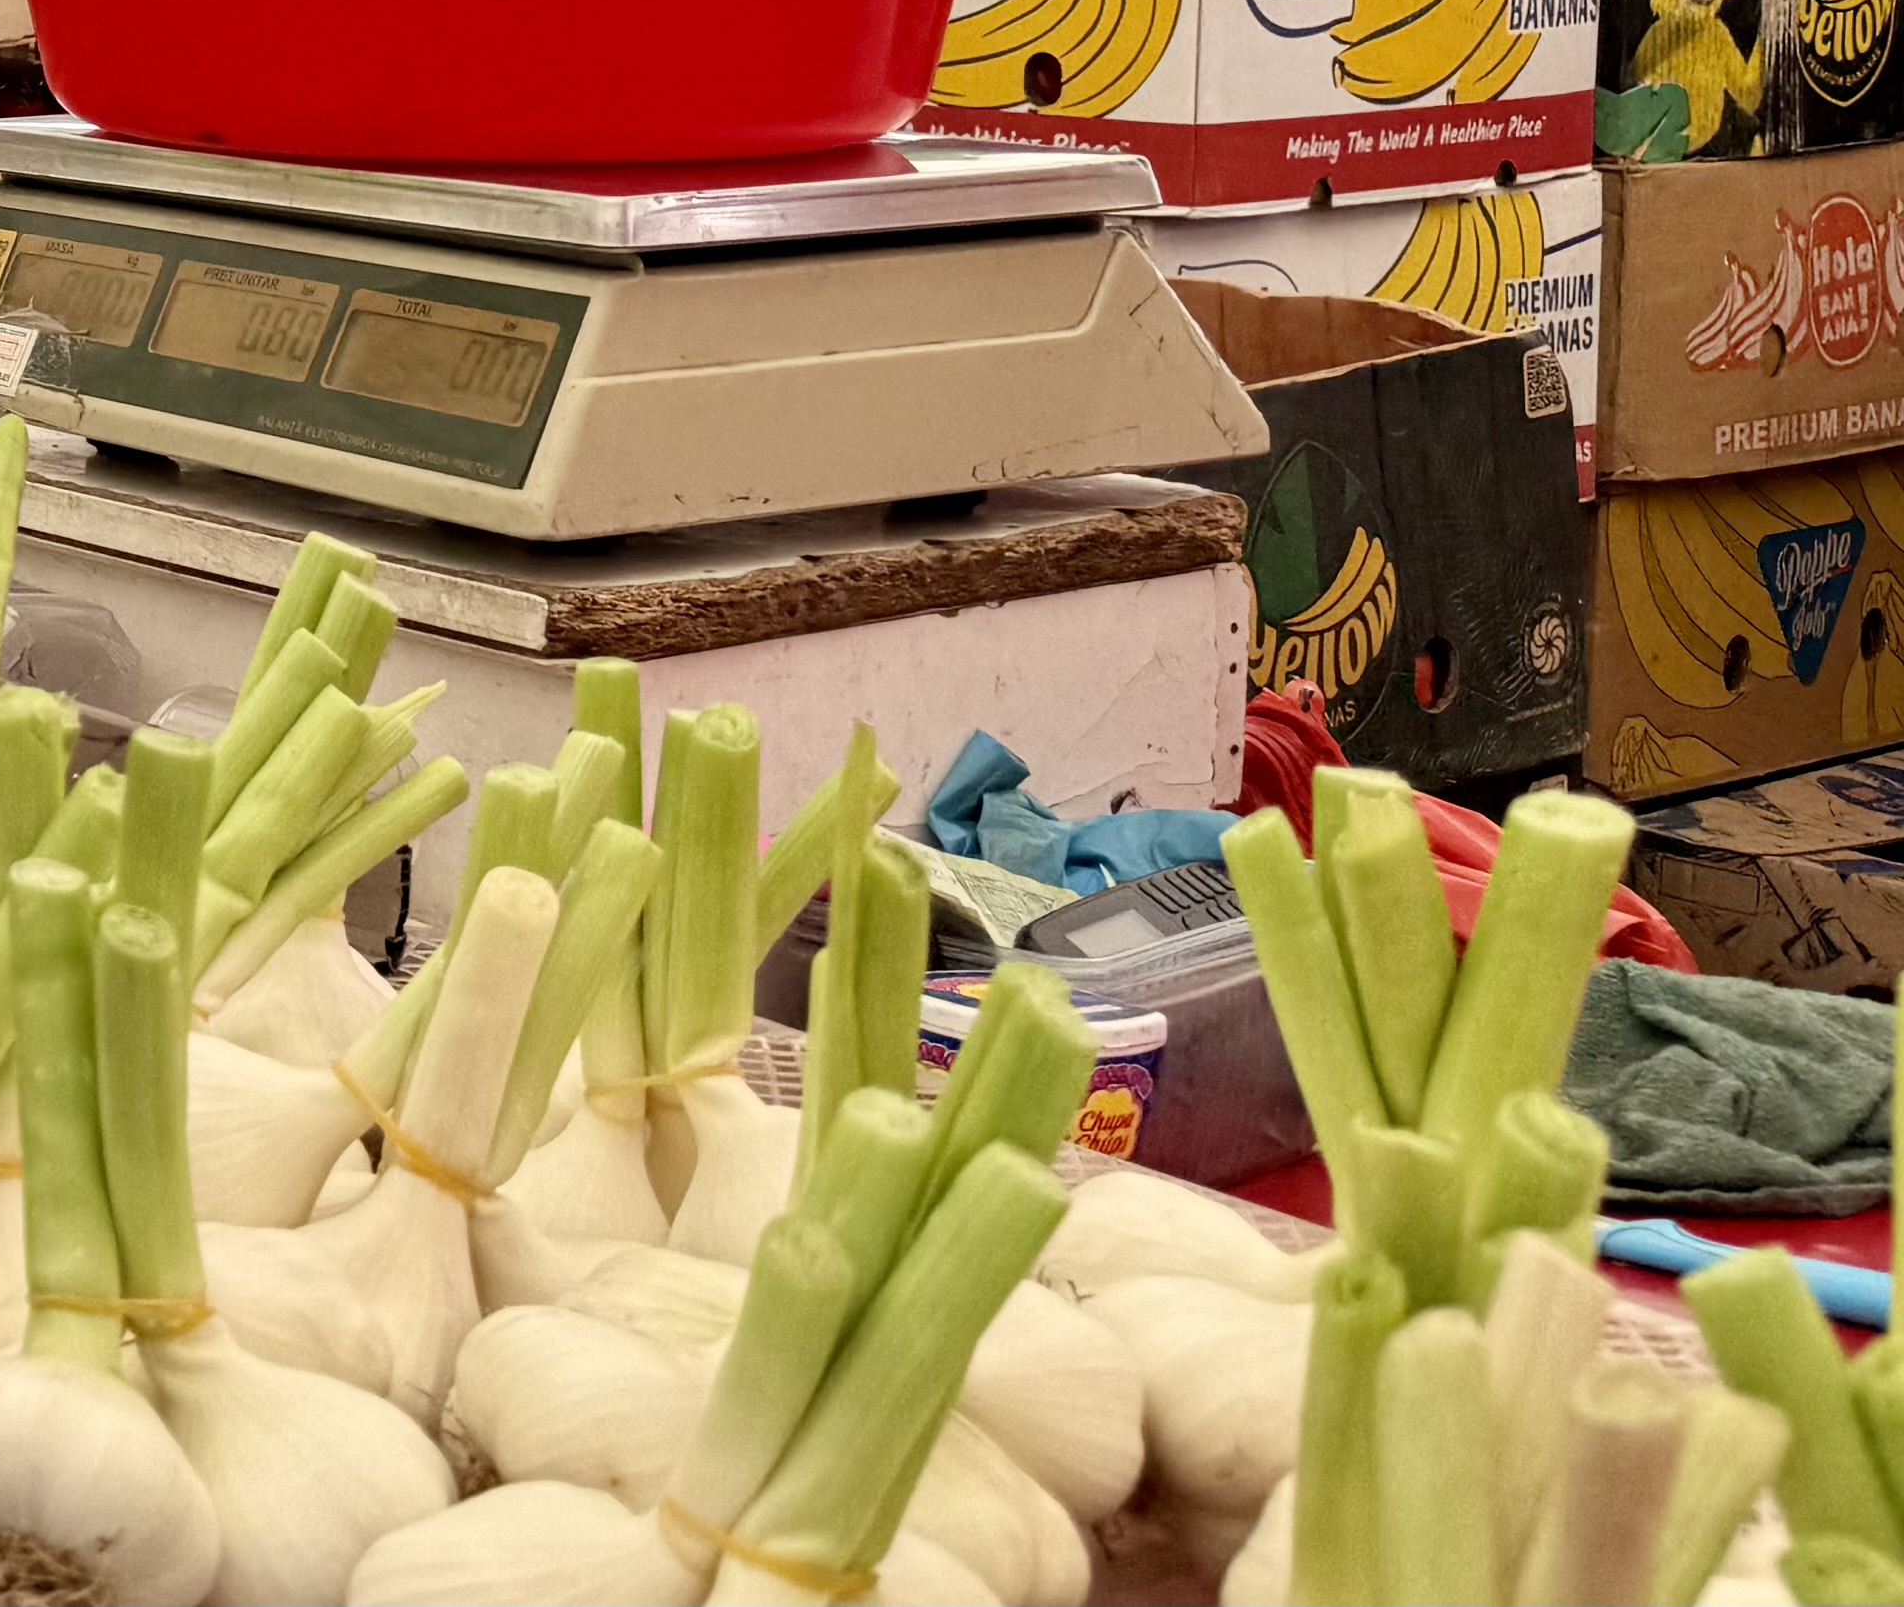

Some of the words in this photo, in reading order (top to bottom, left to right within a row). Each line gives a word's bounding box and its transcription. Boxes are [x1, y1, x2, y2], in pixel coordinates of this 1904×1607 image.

[1286, 133, 1341, 164] Making
[1347, 130, 1373, 154] The
[1378, 123, 1420, 152] World
[1423, 124, 1434, 146] A
[1440, 116, 1505, 145] Healthier
[1507, 114, 1543, 138] Place
[1812, 236, 1875, 288] Hola
[395, 298, 433, 318] TOTAL
[1504, 273, 1594, 316] PREMIUM
[1715, 407, 1838, 455] PREMIUM
[1079, 1110, 1135, 1132] Chupa
